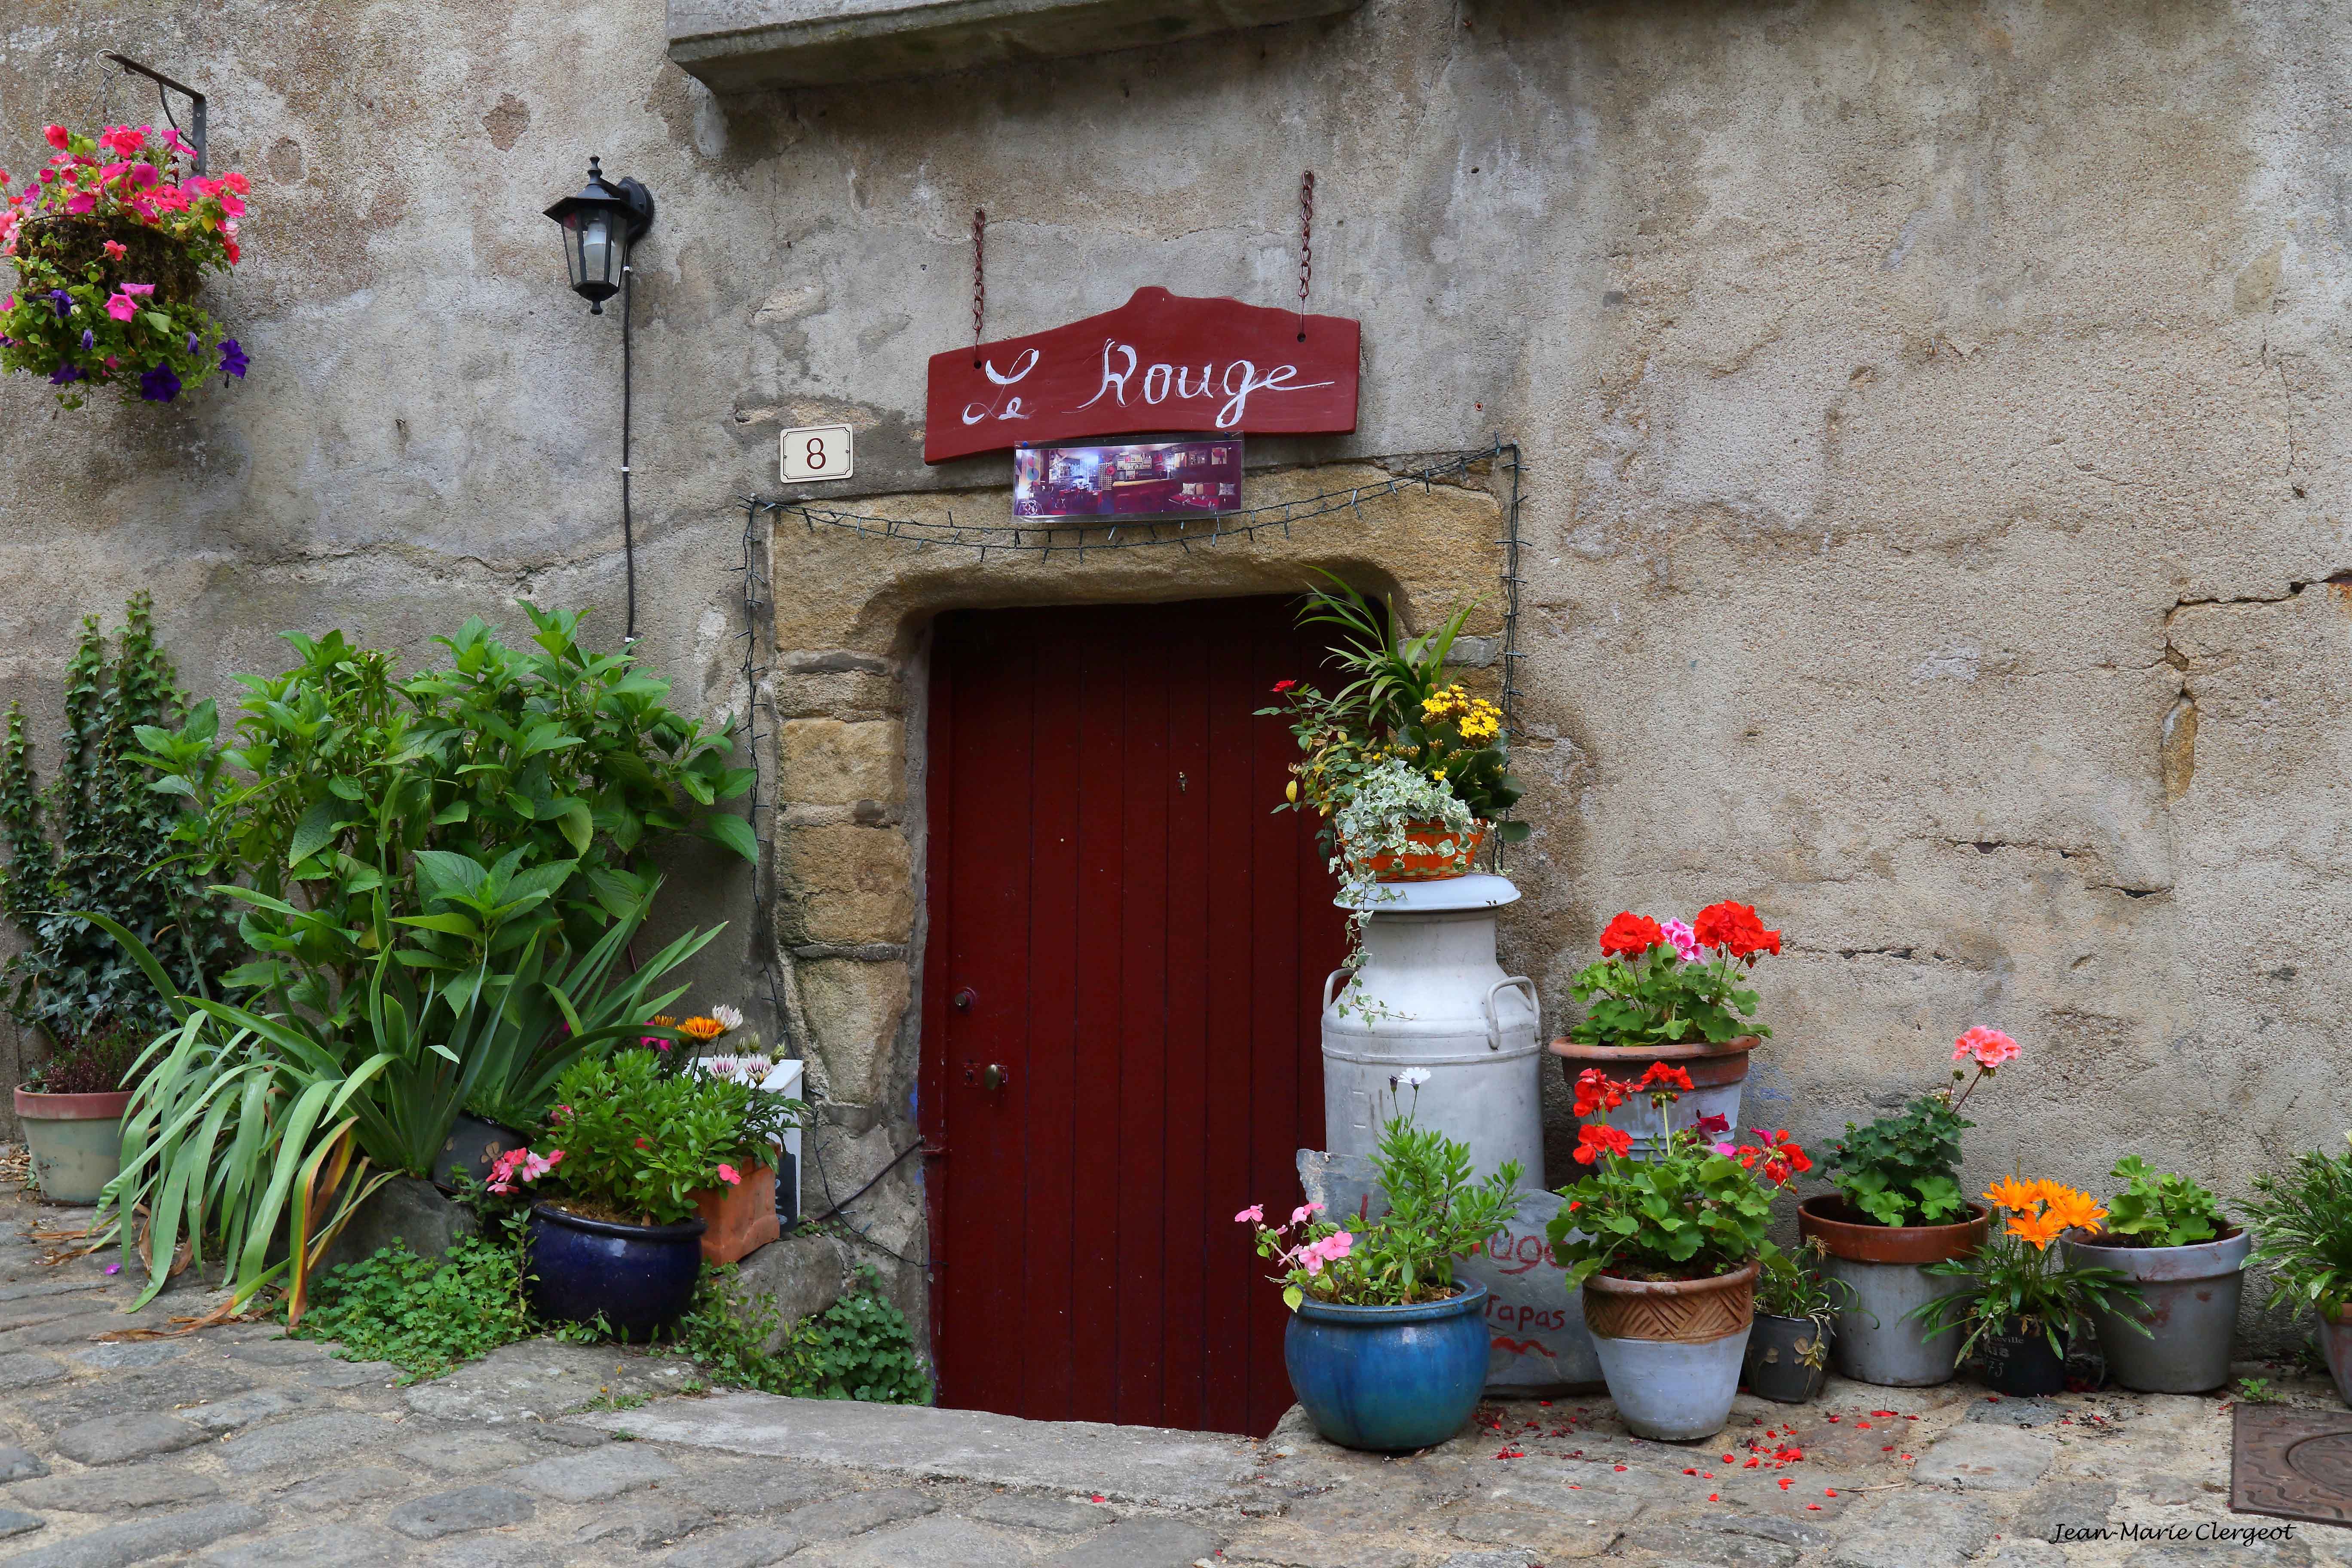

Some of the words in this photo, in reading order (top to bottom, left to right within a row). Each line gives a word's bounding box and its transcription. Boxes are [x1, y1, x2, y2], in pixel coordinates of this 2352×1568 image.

[962, 348, 1039, 425] Le
[1075, 338, 1334, 428] Rouge
[806, 438, 826, 469] 8
[1485, 1294, 1565, 1331] Tapas
